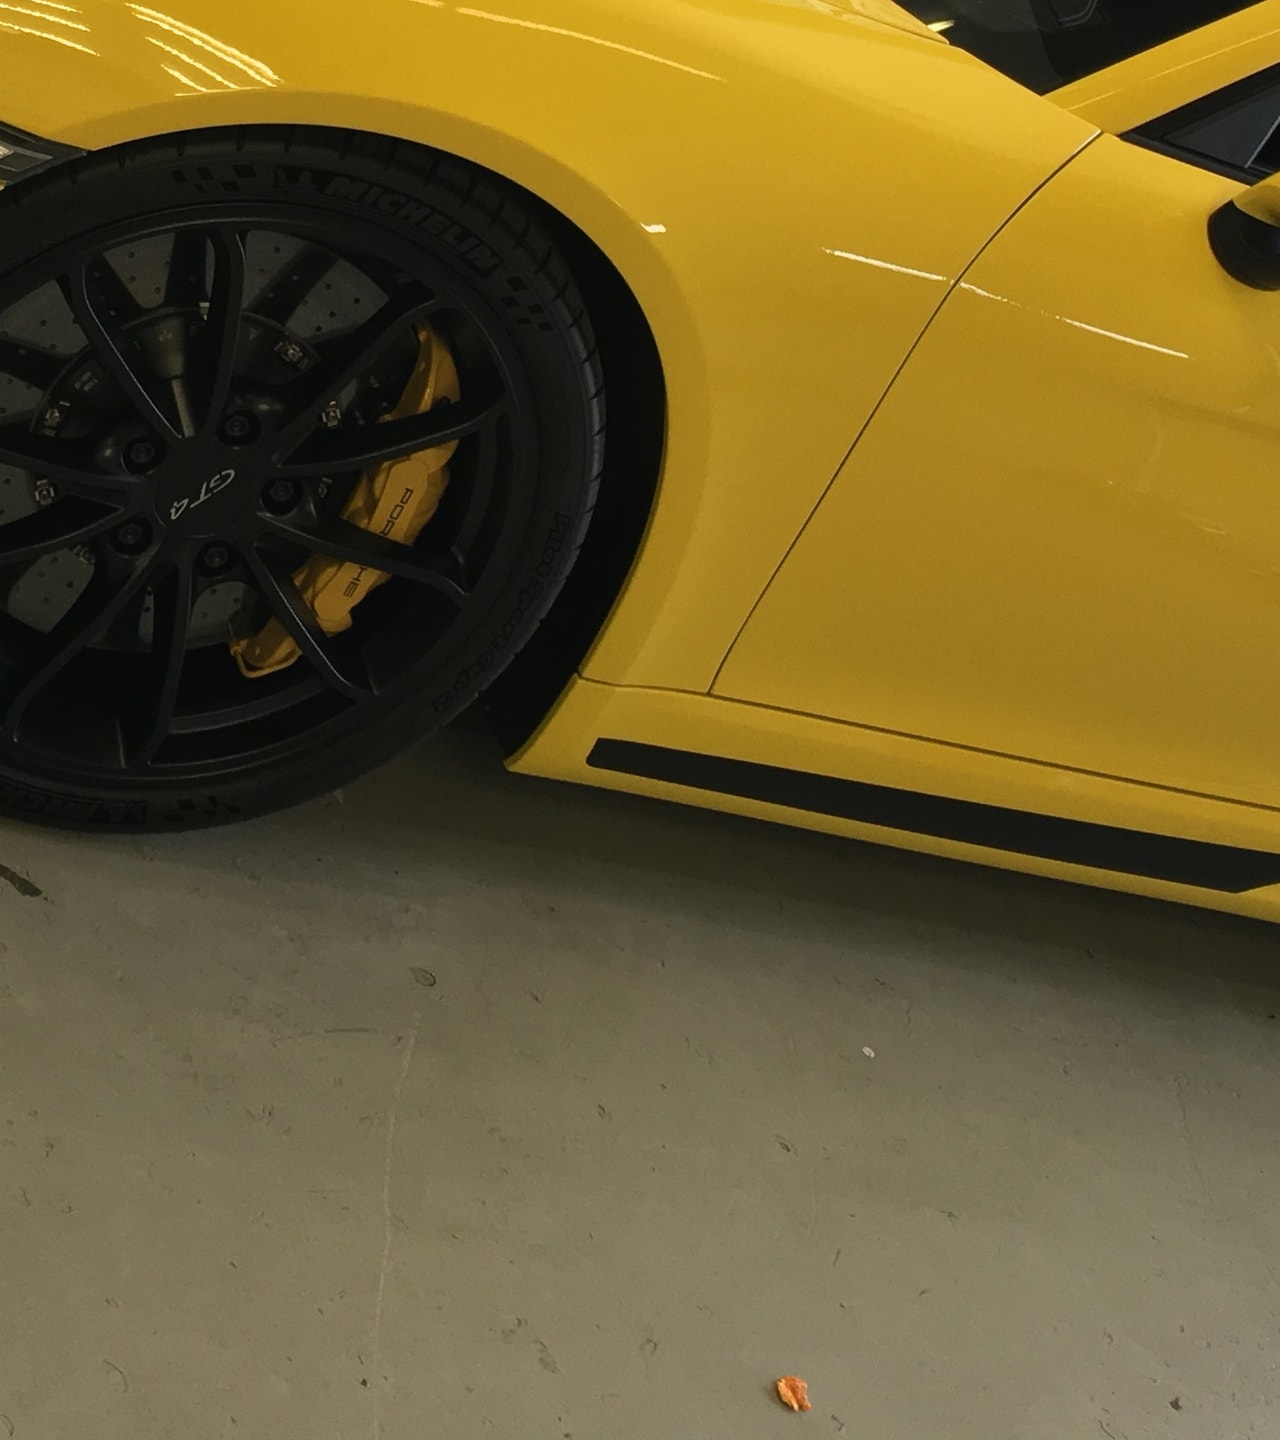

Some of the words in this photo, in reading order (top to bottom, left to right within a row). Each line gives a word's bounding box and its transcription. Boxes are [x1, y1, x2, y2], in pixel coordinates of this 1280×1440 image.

[325, 174, 503, 273] MICHELIN
[168, 469, 234, 521] GT4
[343, 487, 413, 598] PORHE
